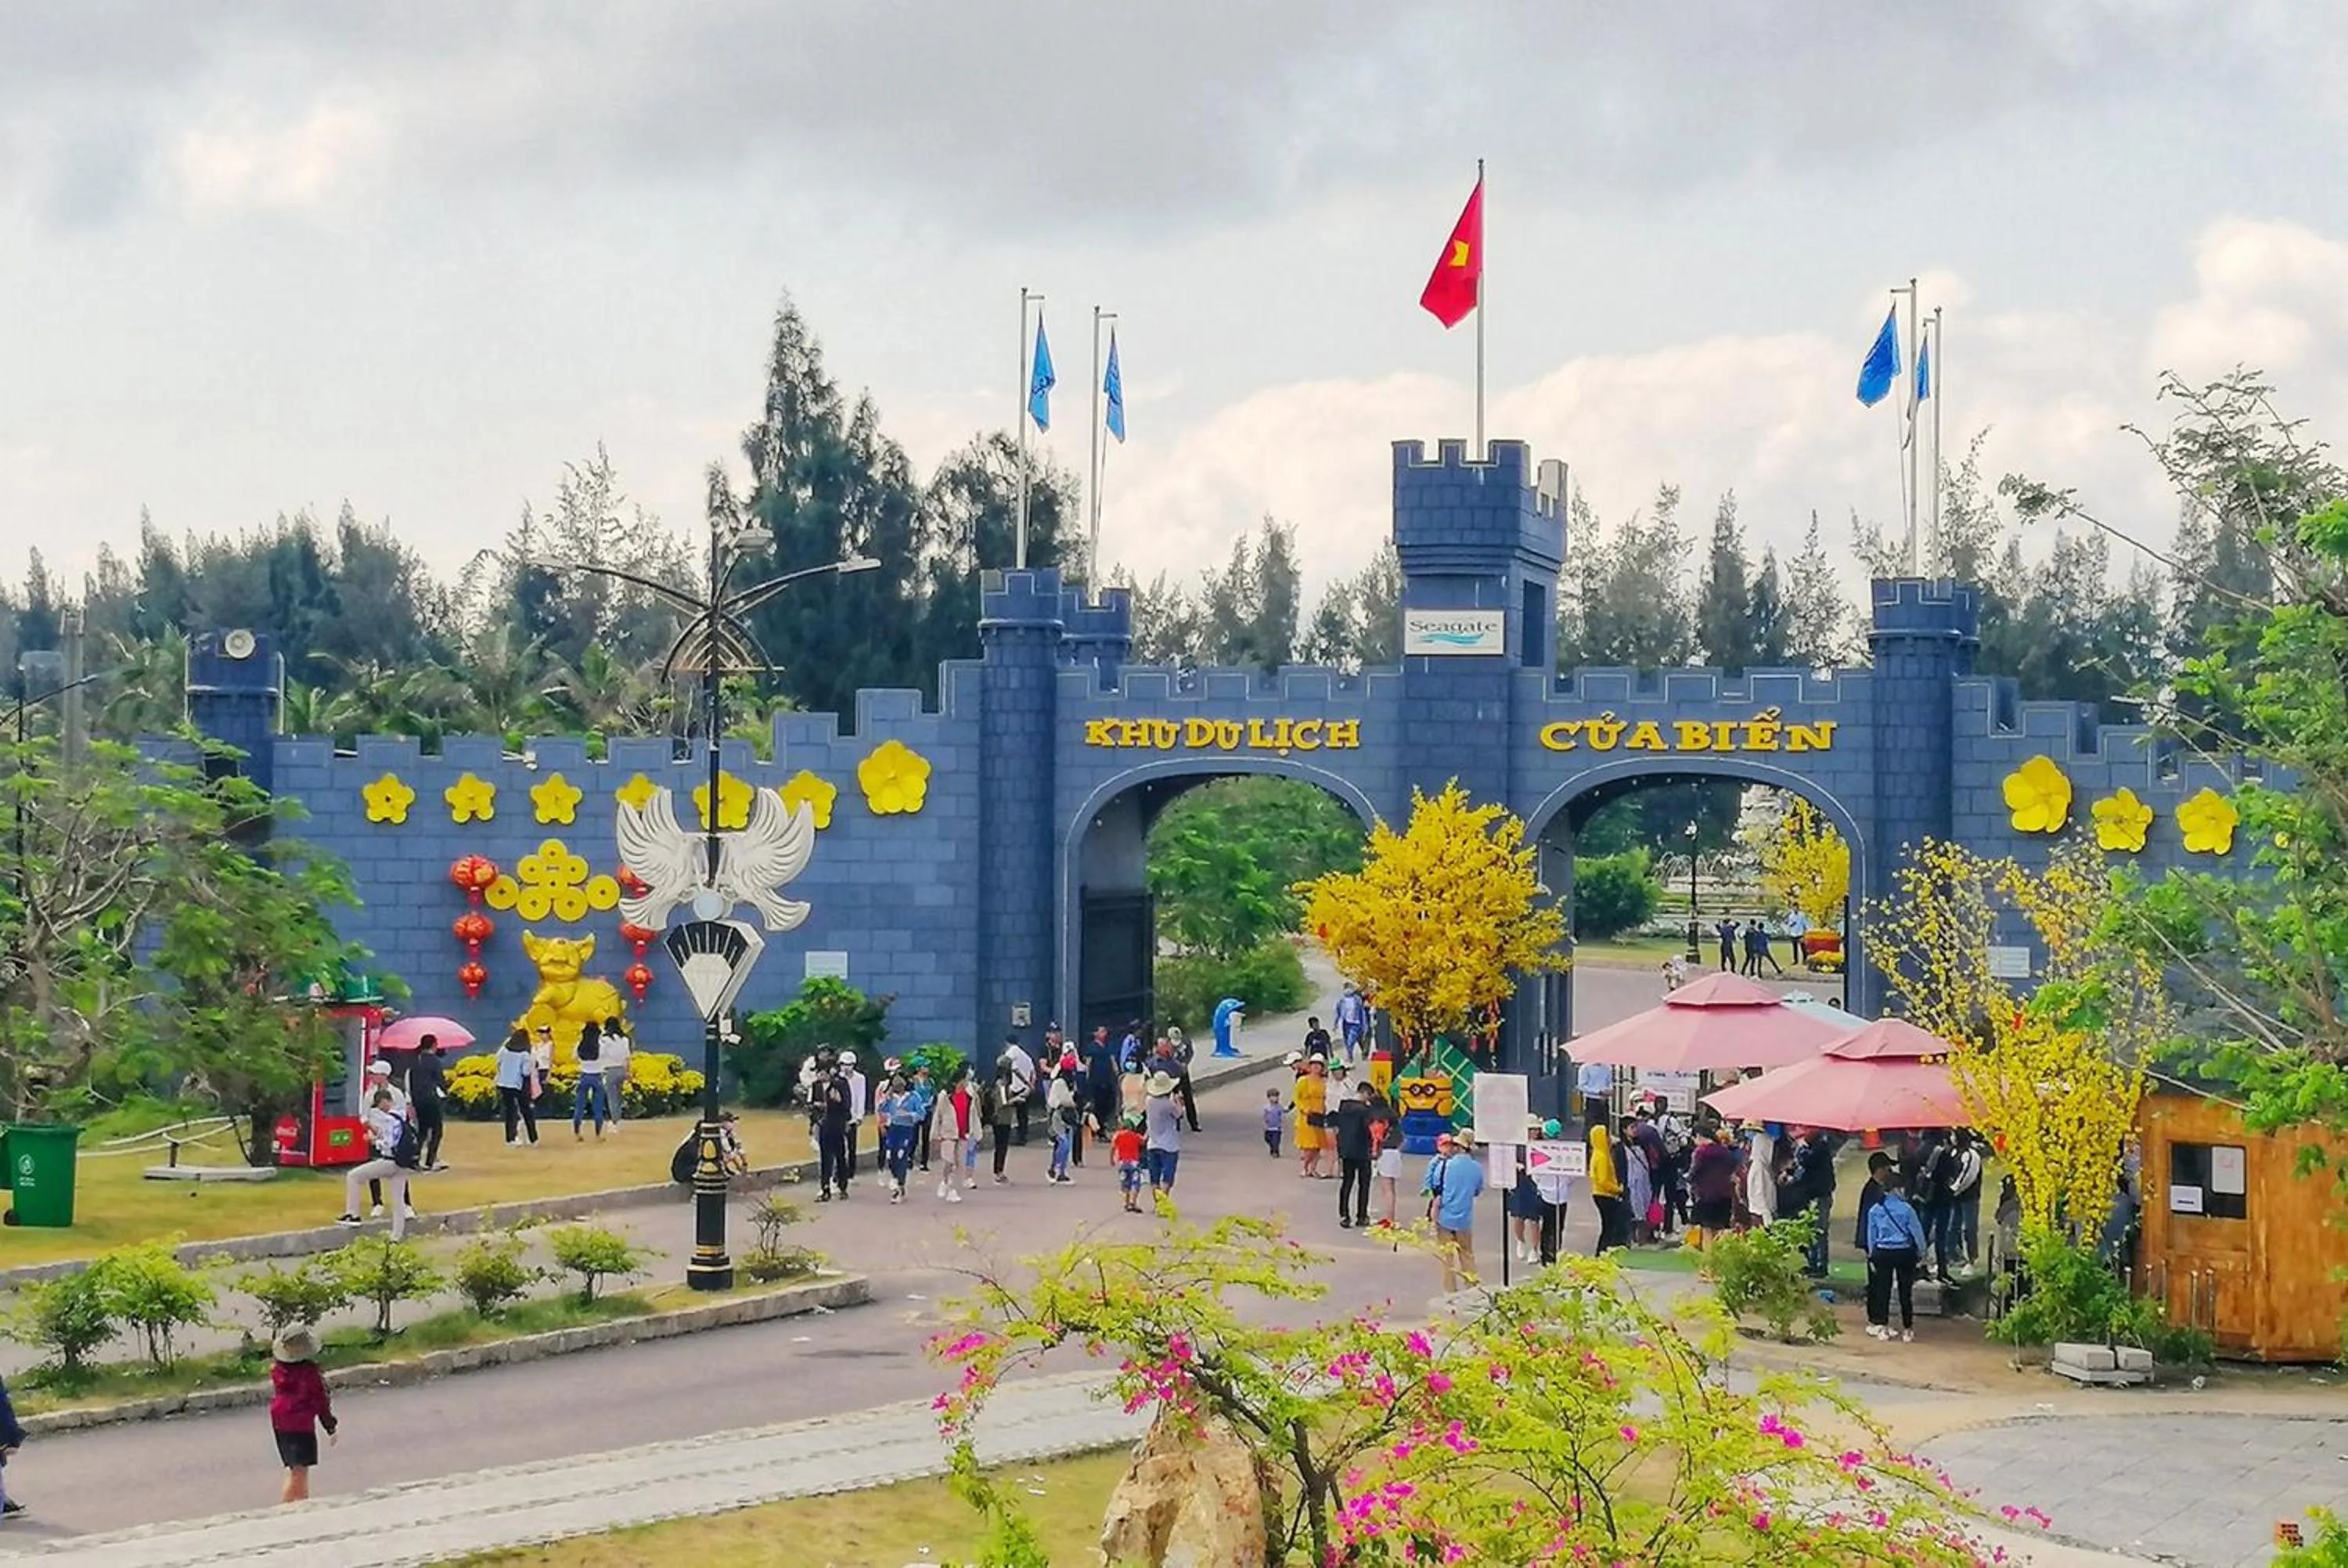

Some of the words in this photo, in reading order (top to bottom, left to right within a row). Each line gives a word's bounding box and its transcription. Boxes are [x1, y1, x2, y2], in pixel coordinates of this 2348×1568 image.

[1410, 620, 1498, 634] Seagate
[1085, 717, 1180, 750] KHU
[1183, 717, 1244, 750] DU
[1248, 717, 1362, 757] LỊCH
[1540, 710, 1669, 751] CỬA
[1673, 707, 1838, 752] BIỂN
